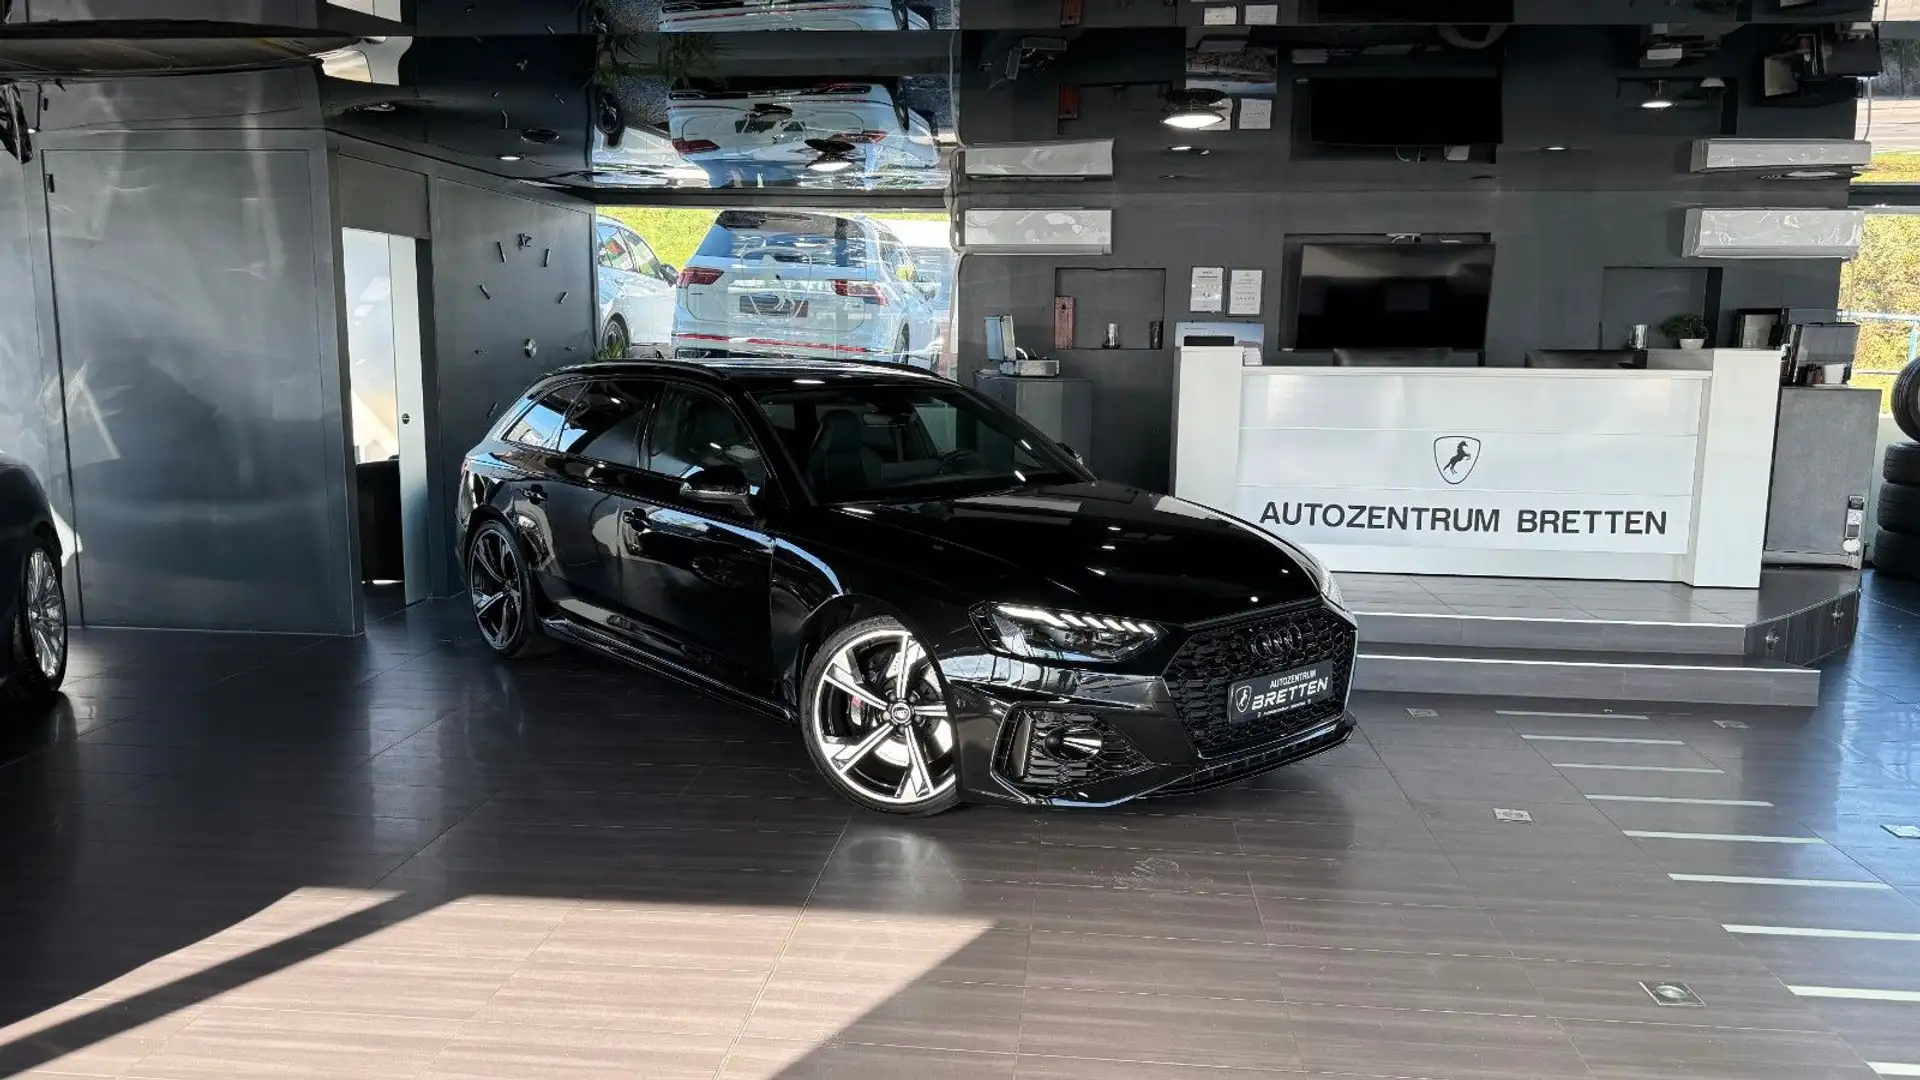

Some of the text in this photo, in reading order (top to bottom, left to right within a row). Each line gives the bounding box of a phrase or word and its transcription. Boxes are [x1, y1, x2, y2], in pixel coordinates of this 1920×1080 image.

[1260, 501, 1667, 535] AUTOZENTRUM BRETTEN
[1251, 676, 1329, 711] BRETTEN
[1270, 669, 1317, 689] AUTOZENTRUM
